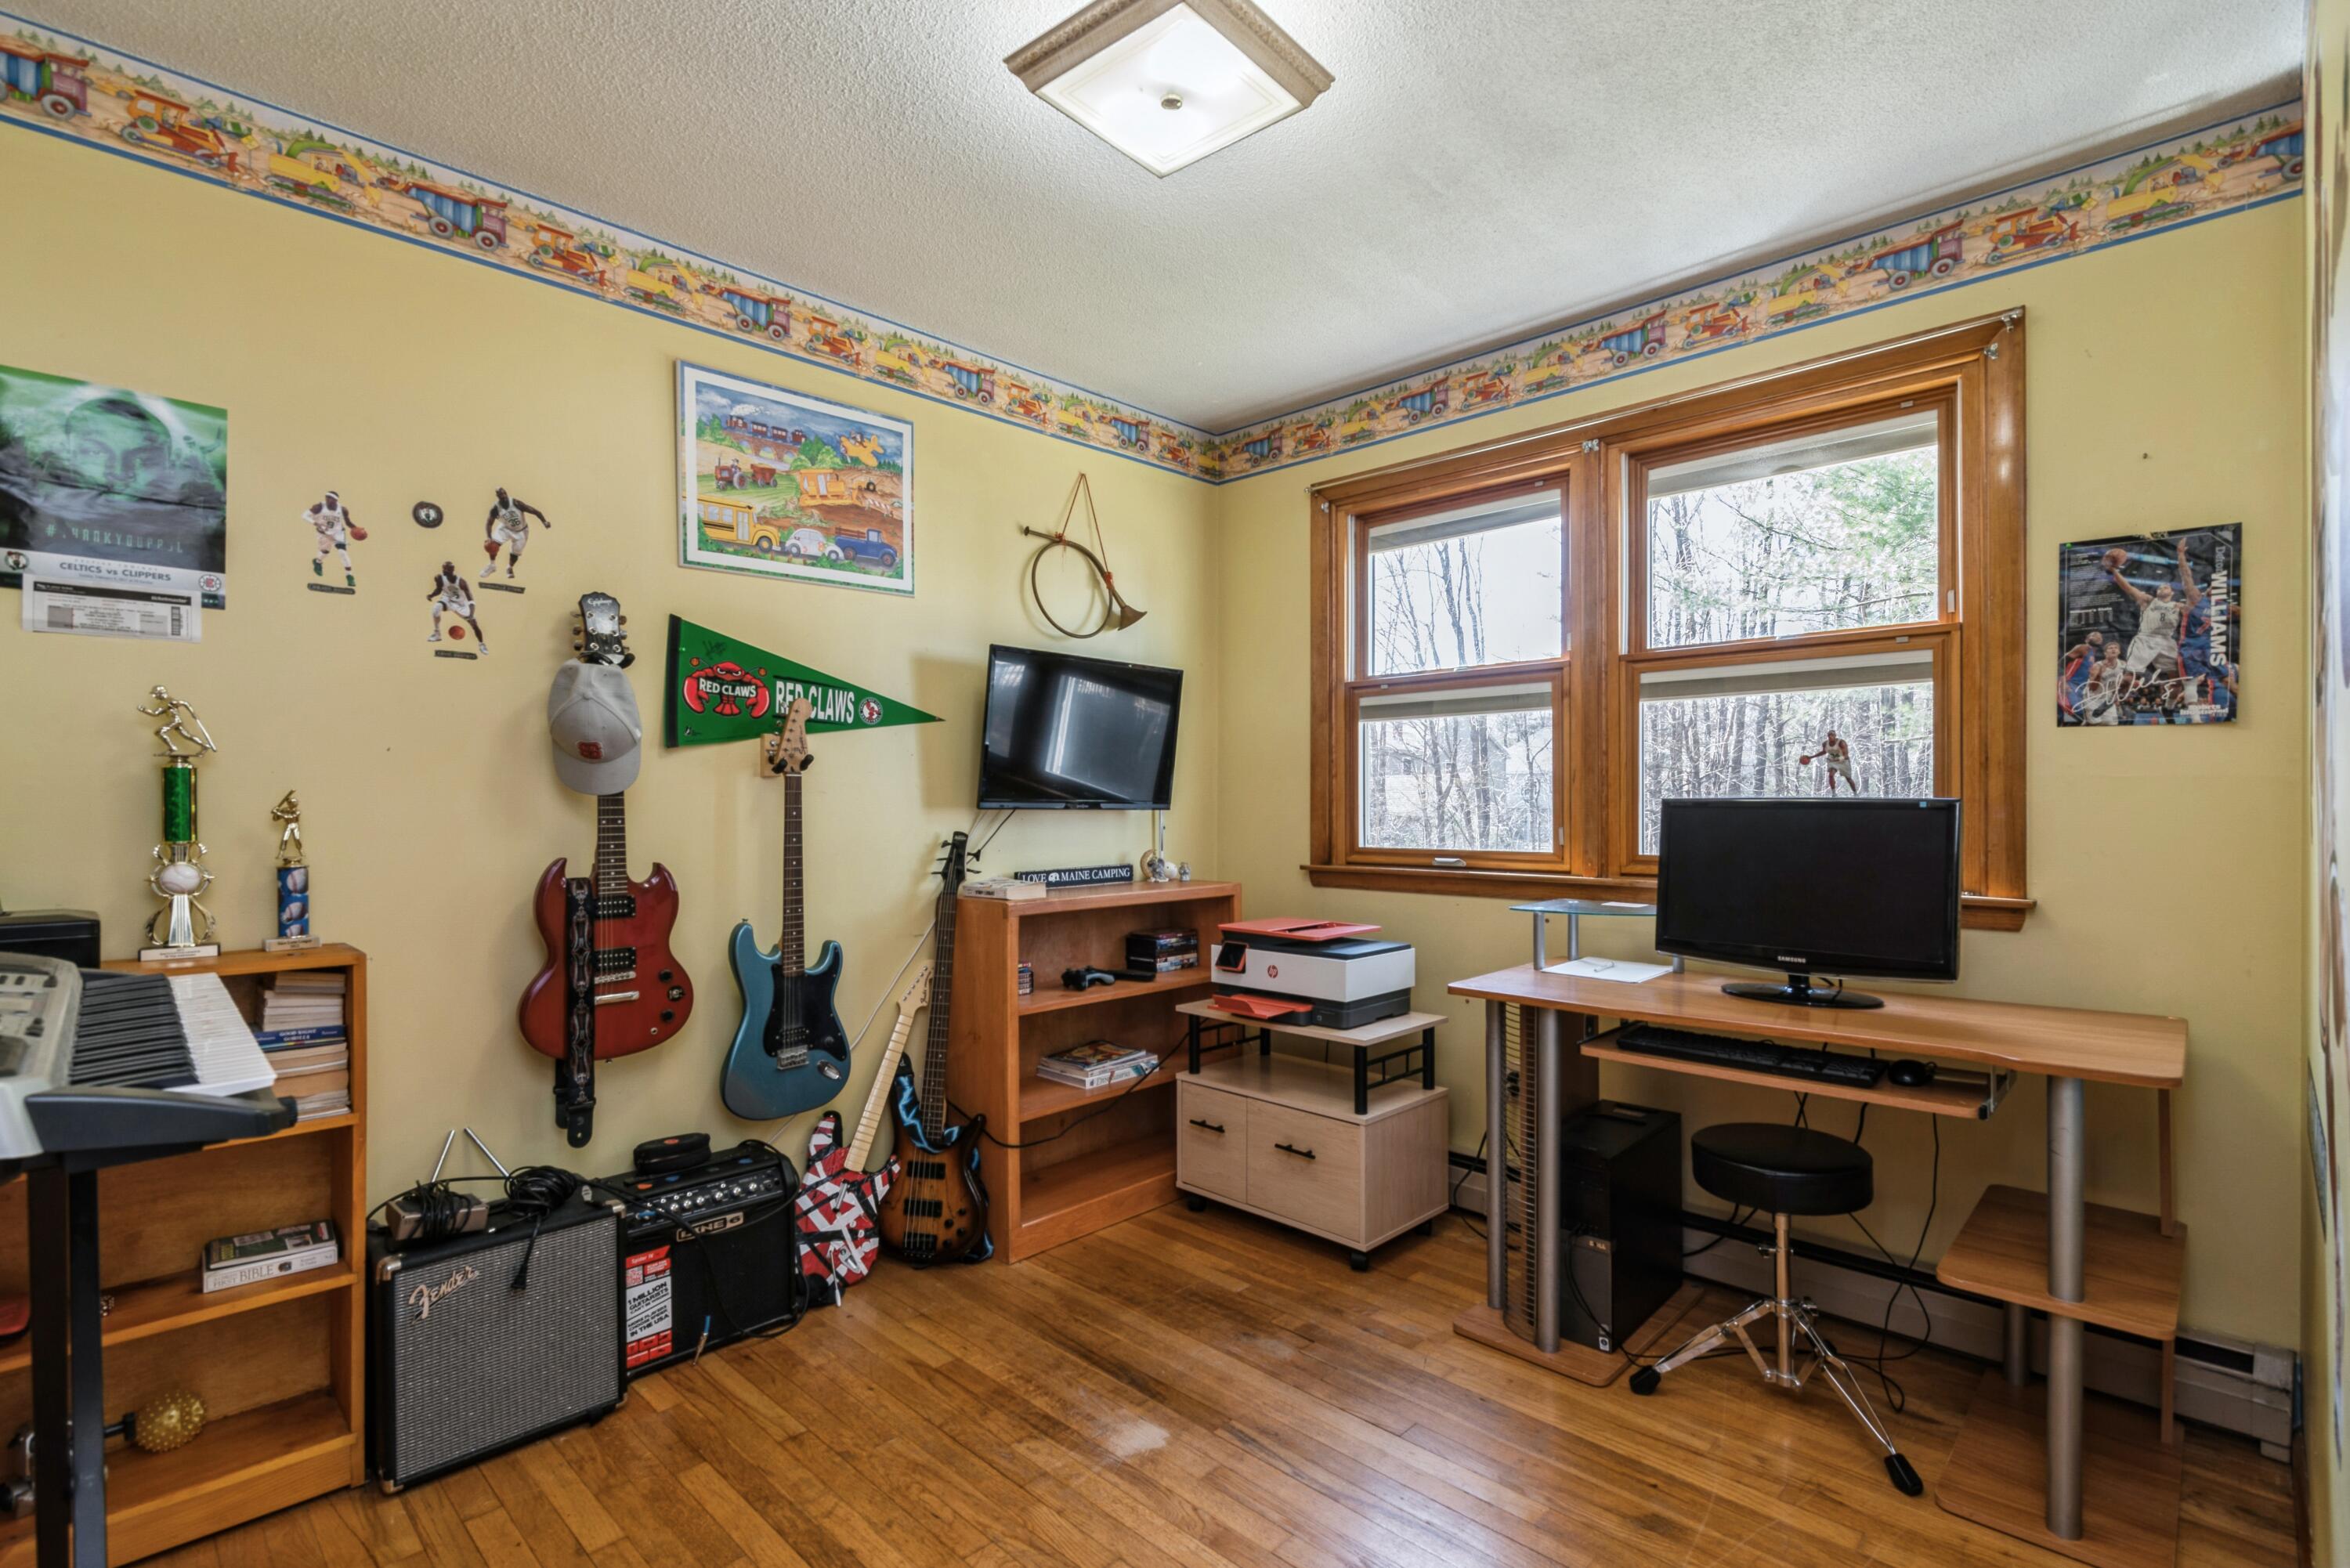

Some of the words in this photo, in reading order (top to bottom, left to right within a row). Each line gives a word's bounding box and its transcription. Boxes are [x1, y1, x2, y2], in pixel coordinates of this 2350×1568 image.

[59, 562, 103, 573] CELTICS
[121, 569, 172, 581] CLIPPERS
[2209, 569, 2228, 667] WILLIAMS
[700, 677, 721, 694] RED
[721, 684, 757, 698] CLAWS
[808, 685, 855, 724] CLAWS
[1021, 873, 1047, 883] LOVE
[1061, 869, 1090, 882] MAINE
[1092, 867, 1131, 880] CAMPING
[1268, 965, 1278, 978] hp
[680, 1219, 725, 1239] LINE
[729, 1216, 741, 1224] 6
[239, 1265, 274, 1282] BIBLE
[409, 1265, 474, 1320] Fender
[629, 1287, 670, 1310] GUITARISTS
[632, 1281, 667, 1304] MILLION
[638, 1321, 653, 1332] THE
[653, 1313, 670, 1324] USA
